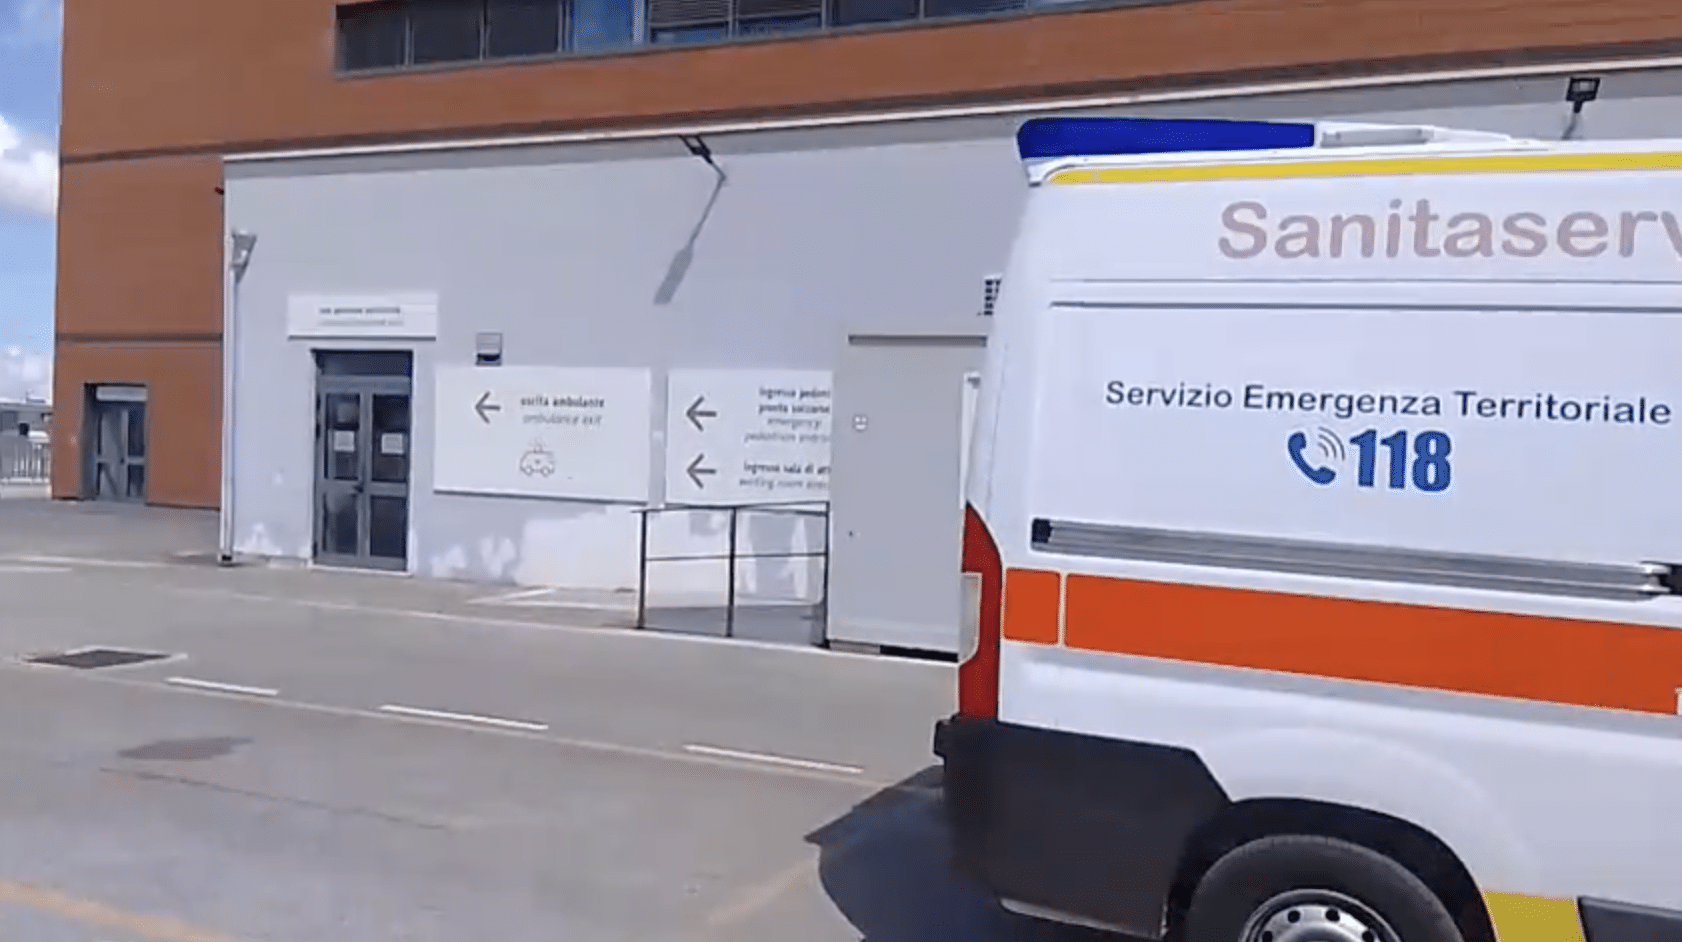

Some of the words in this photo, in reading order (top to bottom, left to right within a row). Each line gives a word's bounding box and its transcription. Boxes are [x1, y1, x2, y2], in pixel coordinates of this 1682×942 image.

[1105, 380, 1234, 409] Servizio
[1242, 385, 1442, 418] Emergenza
[1454, 391, 1672, 425] Territoriale
[1349, 428, 1453, 491] 118
